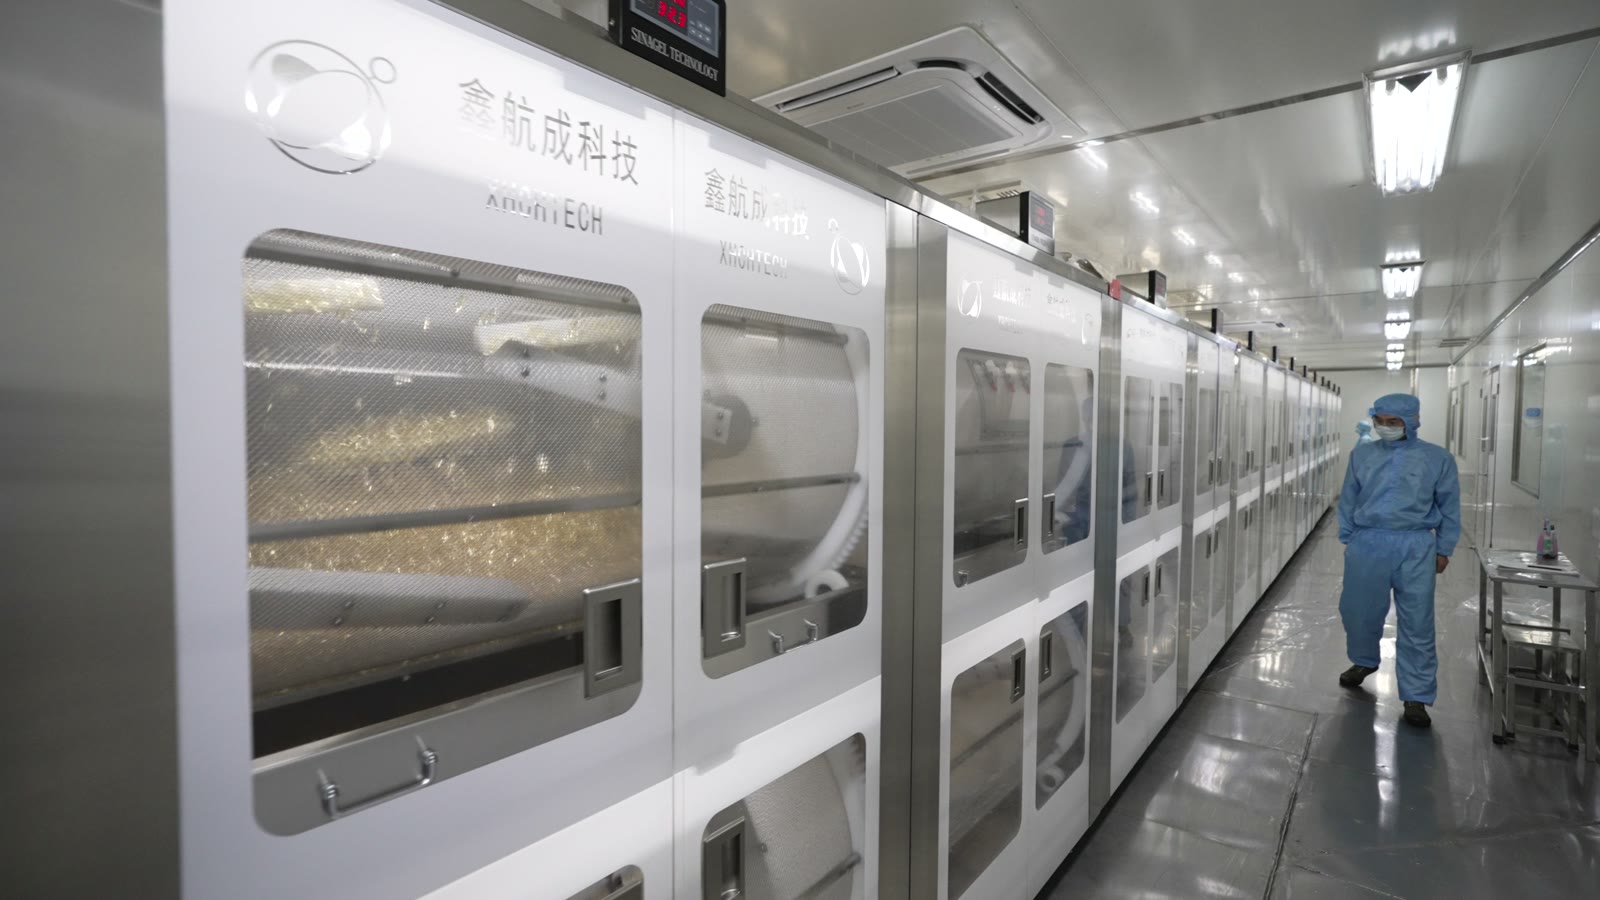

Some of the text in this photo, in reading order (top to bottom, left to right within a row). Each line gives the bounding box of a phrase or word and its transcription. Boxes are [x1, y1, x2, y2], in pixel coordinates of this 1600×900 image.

[631, 27, 718, 81] SINAGEL TECHNOLOGY
[458, 78, 638, 185] 鑫航成科技
